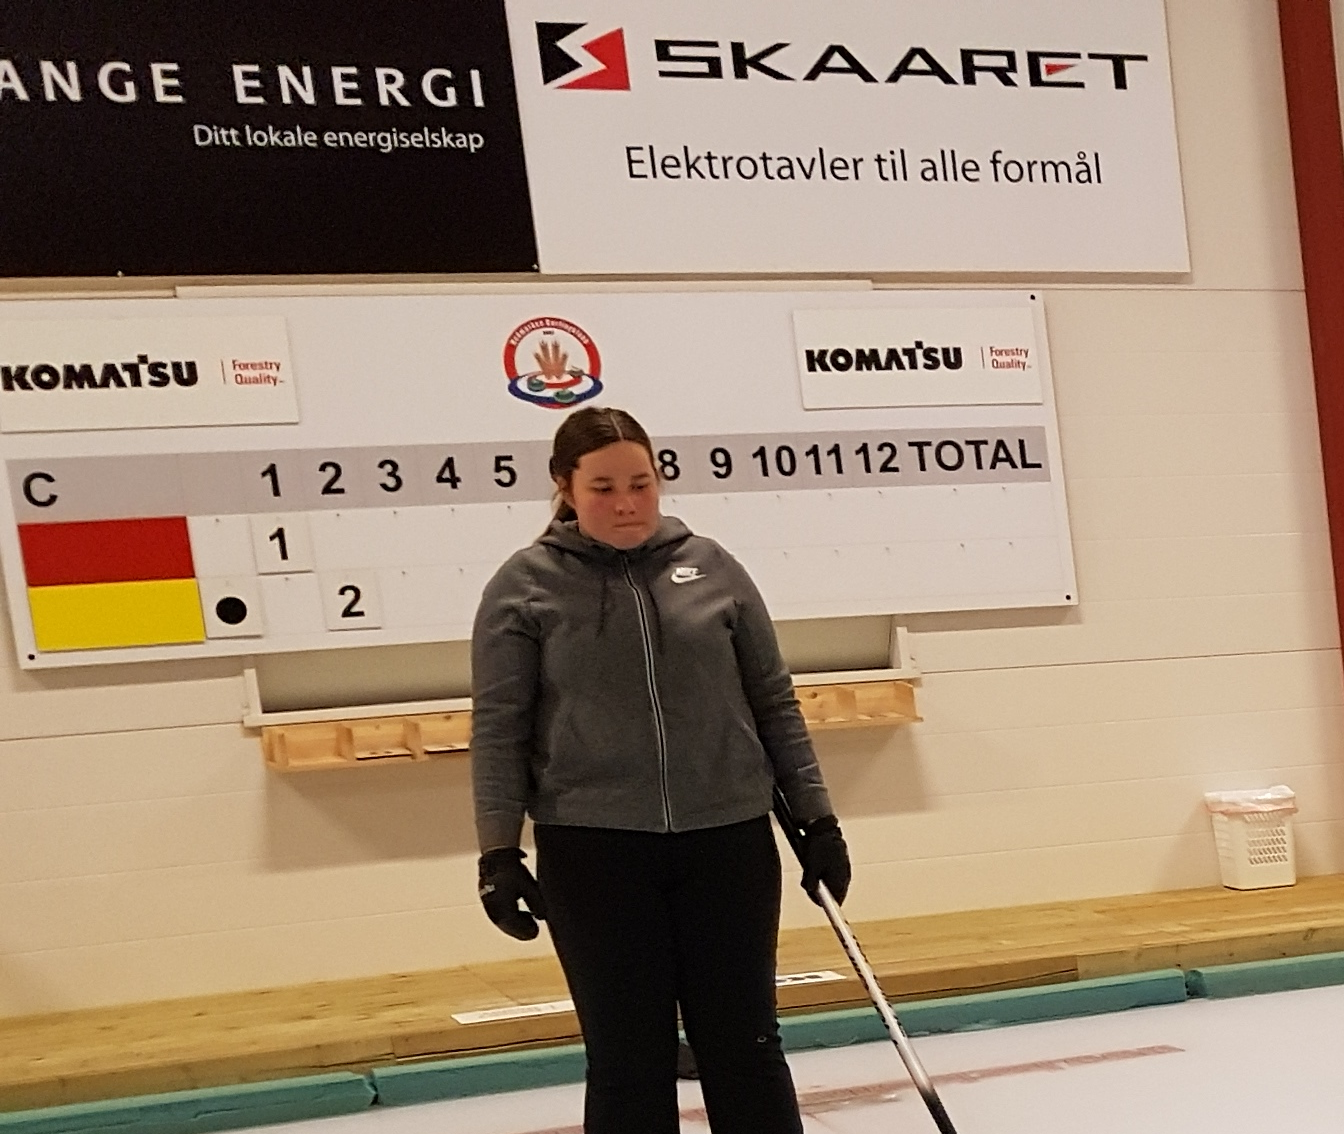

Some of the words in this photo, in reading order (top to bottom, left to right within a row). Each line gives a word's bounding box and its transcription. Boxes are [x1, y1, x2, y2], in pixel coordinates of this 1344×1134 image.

[653, 38, 1149, 91] SKAARET
[232, 64, 484, 108] ENERGI
[193, 124, 241, 146] Ditt
[245, 124, 318, 147] lokale
[323, 126, 485, 153] energiselskap
[625, 144, 864, 181] Elektrotavler
[874, 148, 908, 182] til
[920, 149, 980, 183] alle
[989, 149, 1102, 184] formål
[232, 359, 281, 372] Forestry
[805, 340, 963, 373] KOMATSU
[989, 346, 1029, 358] Forestry
[991, 358, 1026, 371] Quality
[0, 354, 199, 392] KOMATSU
[234, 373, 277, 387] Quality
[22, 472, 58, 508] C
[260, 463, 281, 497] 1
[318, 461, 346, 496] 2
[377, 459, 403, 493] 3
[435, 456, 462, 490] 4
[494, 454, 517, 488] 5
[657, 448, 681, 481] 8
[709, 447, 733, 479] 9
[751, 445, 797, 478] 10
[805, 443, 844, 476] 11
[854, 441, 900, 474] 12
[907, 438, 1043, 472] TOTAL
[269, 527, 289, 561] 1
[338, 584, 365, 618] 2
